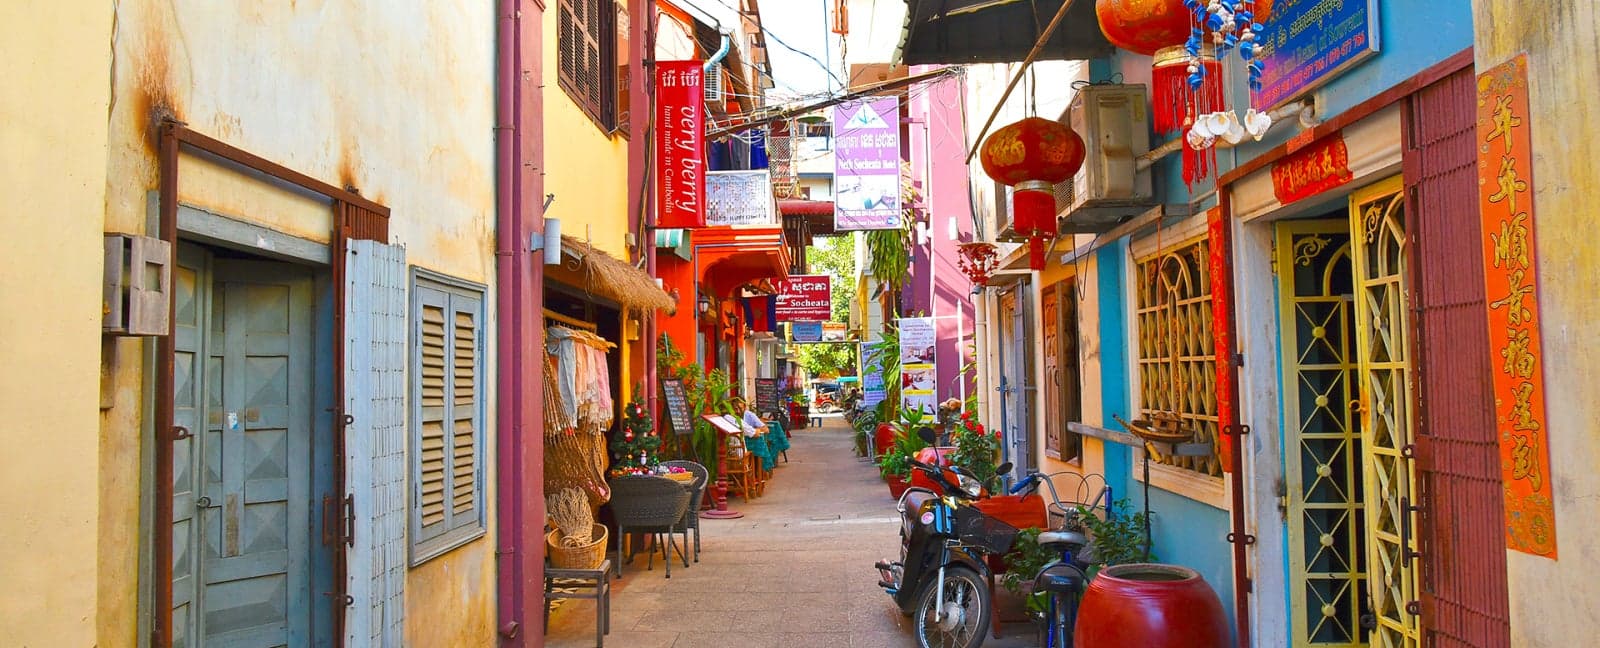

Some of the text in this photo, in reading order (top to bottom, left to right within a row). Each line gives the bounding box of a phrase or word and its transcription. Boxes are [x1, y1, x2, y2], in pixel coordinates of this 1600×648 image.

[664, 105, 675, 214] hand made in Cambodia
[674, 105, 702, 213] very berry
[882, 159, 897, 169] Hotel
[790, 299, 830, 307] Socheata
